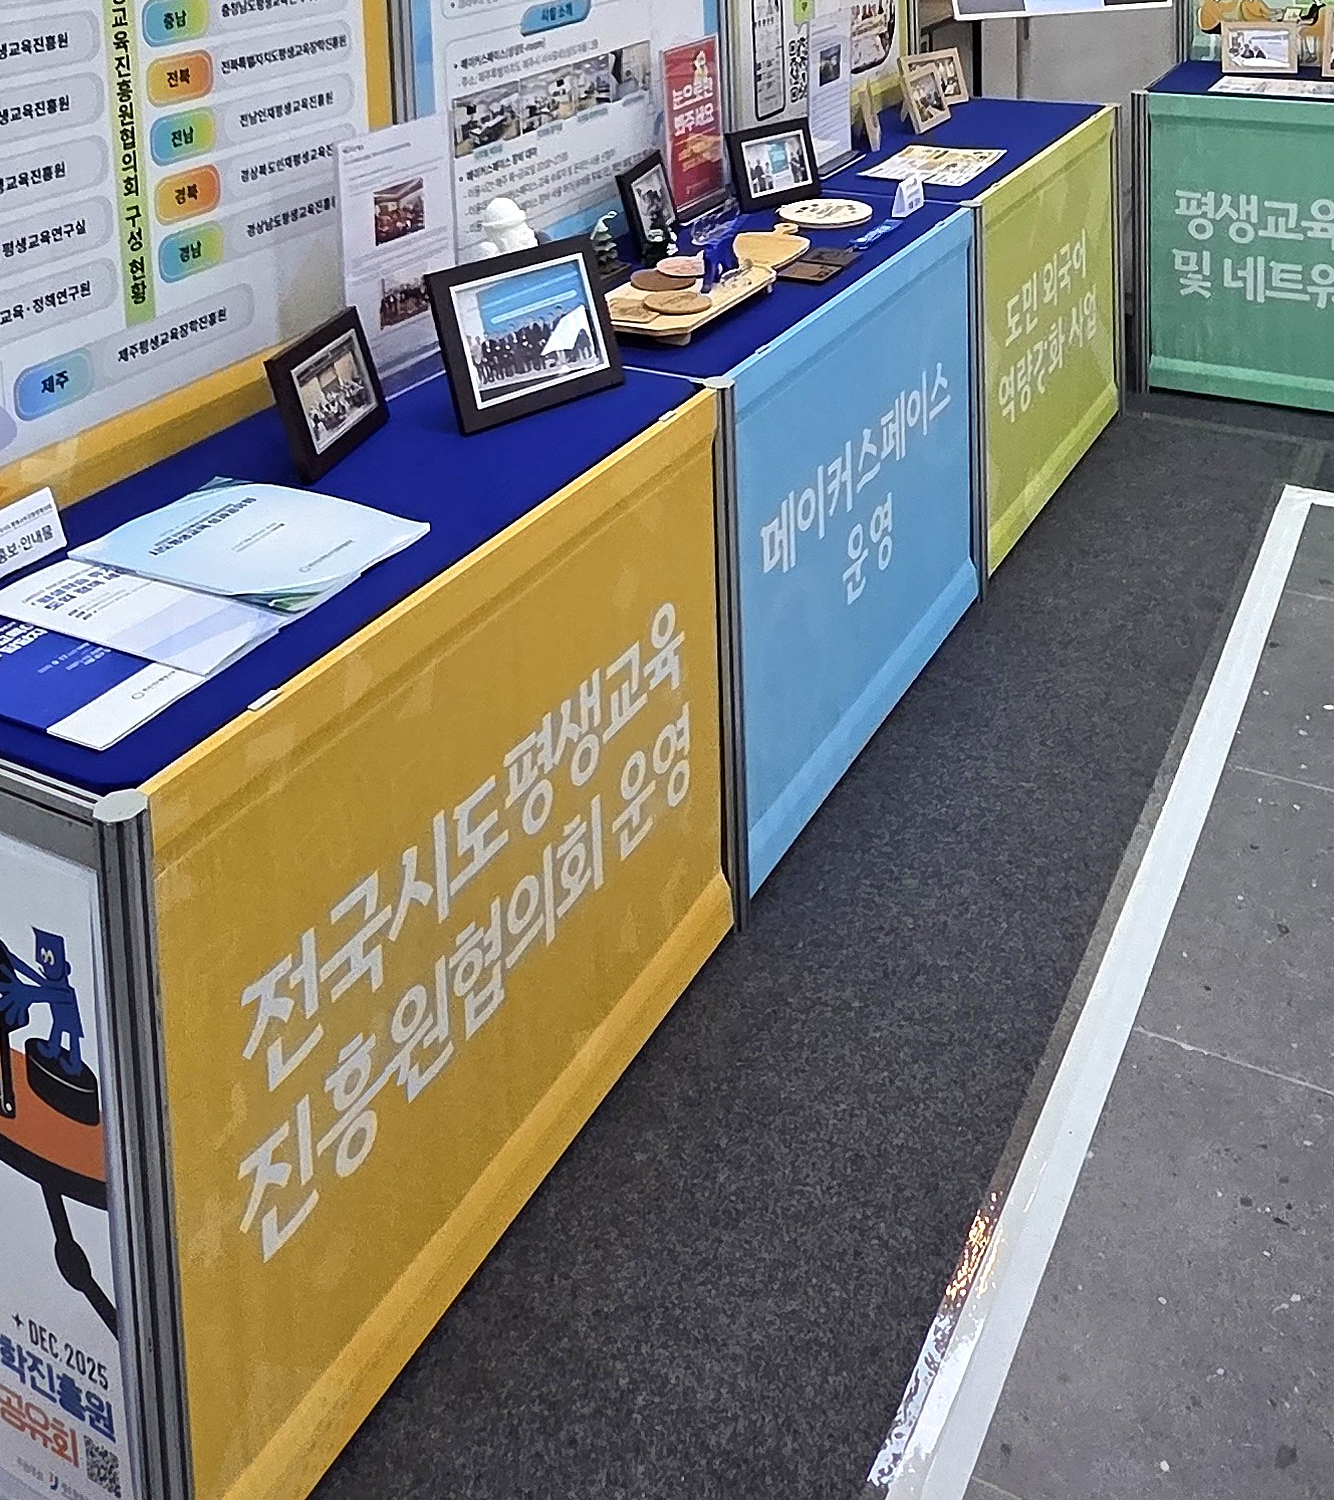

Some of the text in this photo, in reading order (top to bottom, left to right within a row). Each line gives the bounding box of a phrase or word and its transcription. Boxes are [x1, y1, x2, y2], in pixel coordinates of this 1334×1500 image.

[163, 9, 186, 30] 충남
[2, 219, 86, 257] 평생교육연구실
[125, 204, 143, 251] 구성
[128, 256, 147, 304] 현황
[1004, 227, 1087, 348] 도민 외국어
[1171, 247, 1212, 297] 및
[118, 307, 227, 361] 제주평생교육장학진흥원
[1069, 283, 1098, 349] 사업
[41, 370, 69, 393] 제주
[760, 371, 951, 576] 메이커스페이스
[842, 493, 895, 607] 운영
[239, 601, 685, 1094] 전국시도평생교육
[236, 701, 692, 1264] 진흥원협의회 운영
[64, 1343, 109, 1391] 2025
